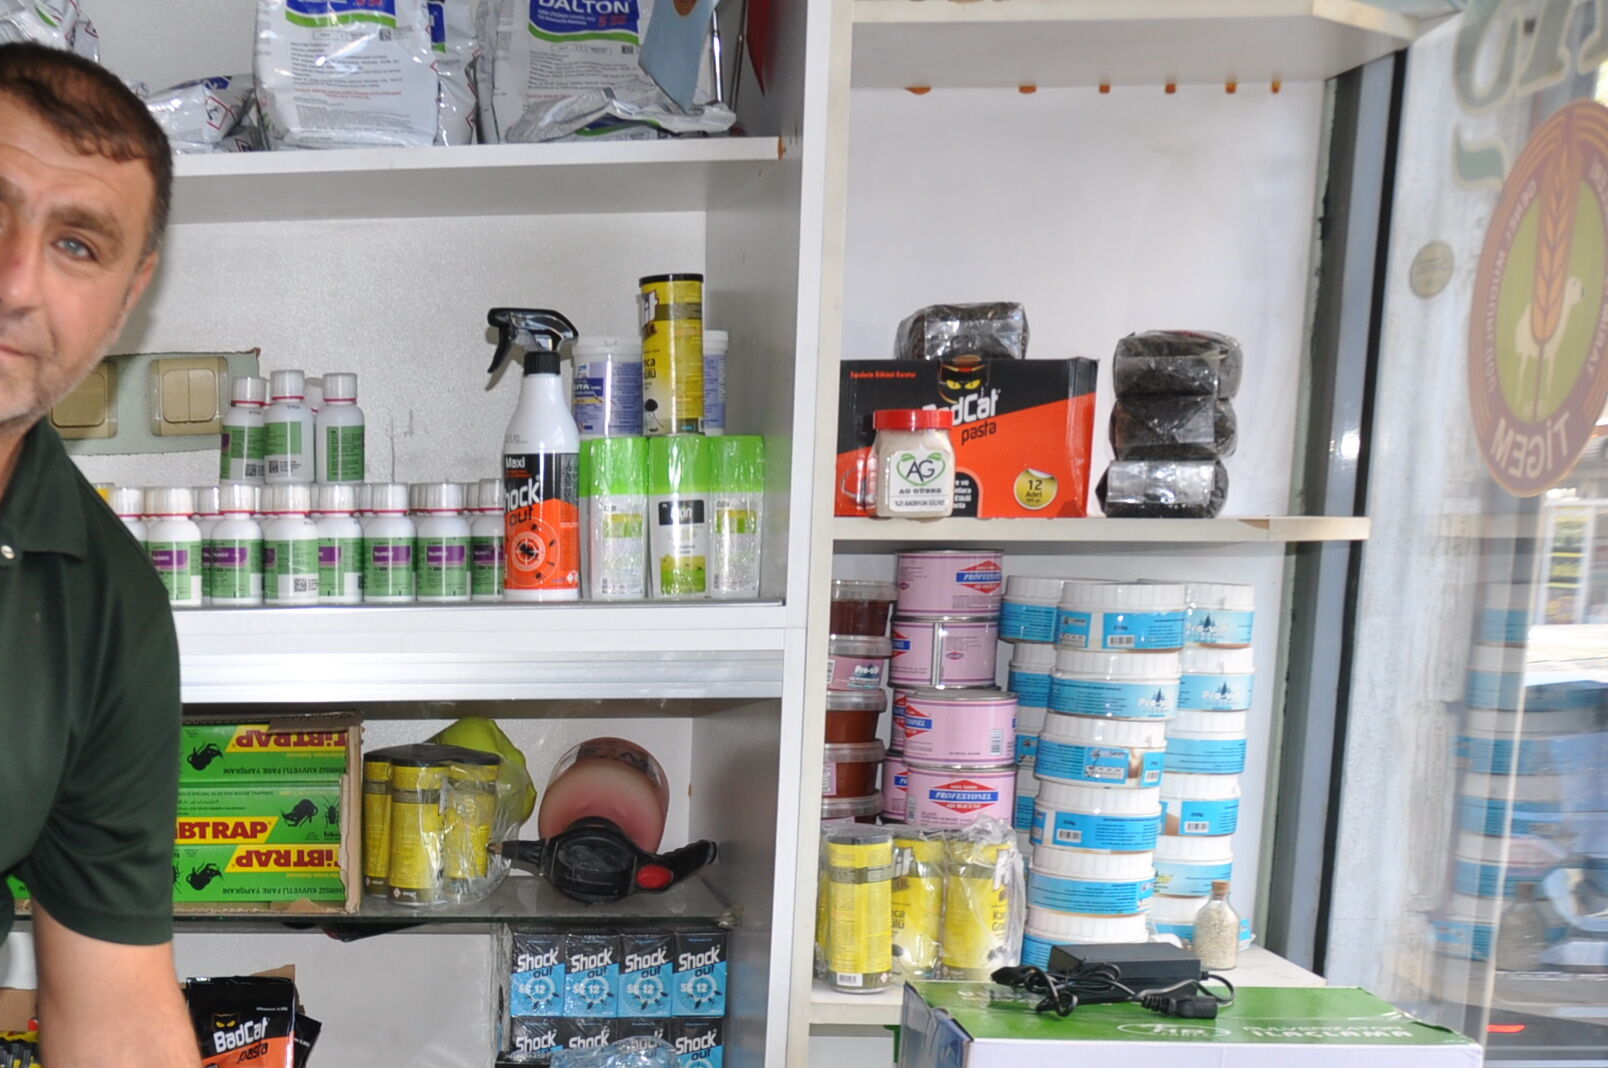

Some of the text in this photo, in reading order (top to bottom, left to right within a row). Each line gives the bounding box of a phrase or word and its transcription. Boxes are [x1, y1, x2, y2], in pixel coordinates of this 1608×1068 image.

[922, 388, 1000, 424] dCat
[961, 421, 997, 446] pasta
[505, 457, 525, 469] Maxi
[906, 459, 935, 482] AG
[1029, 480, 1042, 490] 12
[176, 821, 268, 839] BTRAP
[517, 948, 559, 974] Shock
[571, 948, 612, 973] Shock
[624, 947, 667, 973] Shock
[678, 946, 720, 972] Shock
[532, 966, 553, 979] out
[587, 966, 607, 979] out
[641, 966, 662, 978] out
[694, 965, 715, 978] out
[534, 983, 546, 994] 12
[588, 983, 599, 994] 12
[643, 983, 654, 994] 12
[696, 983, 707, 993] 12
[213, 1017, 268, 1054] BadCat
[515, 1031, 557, 1053] Shock
[675, 1029, 717, 1055] Shock
[236, 1041, 269, 1065] pasta
[691, 1049, 712, 1061] out
